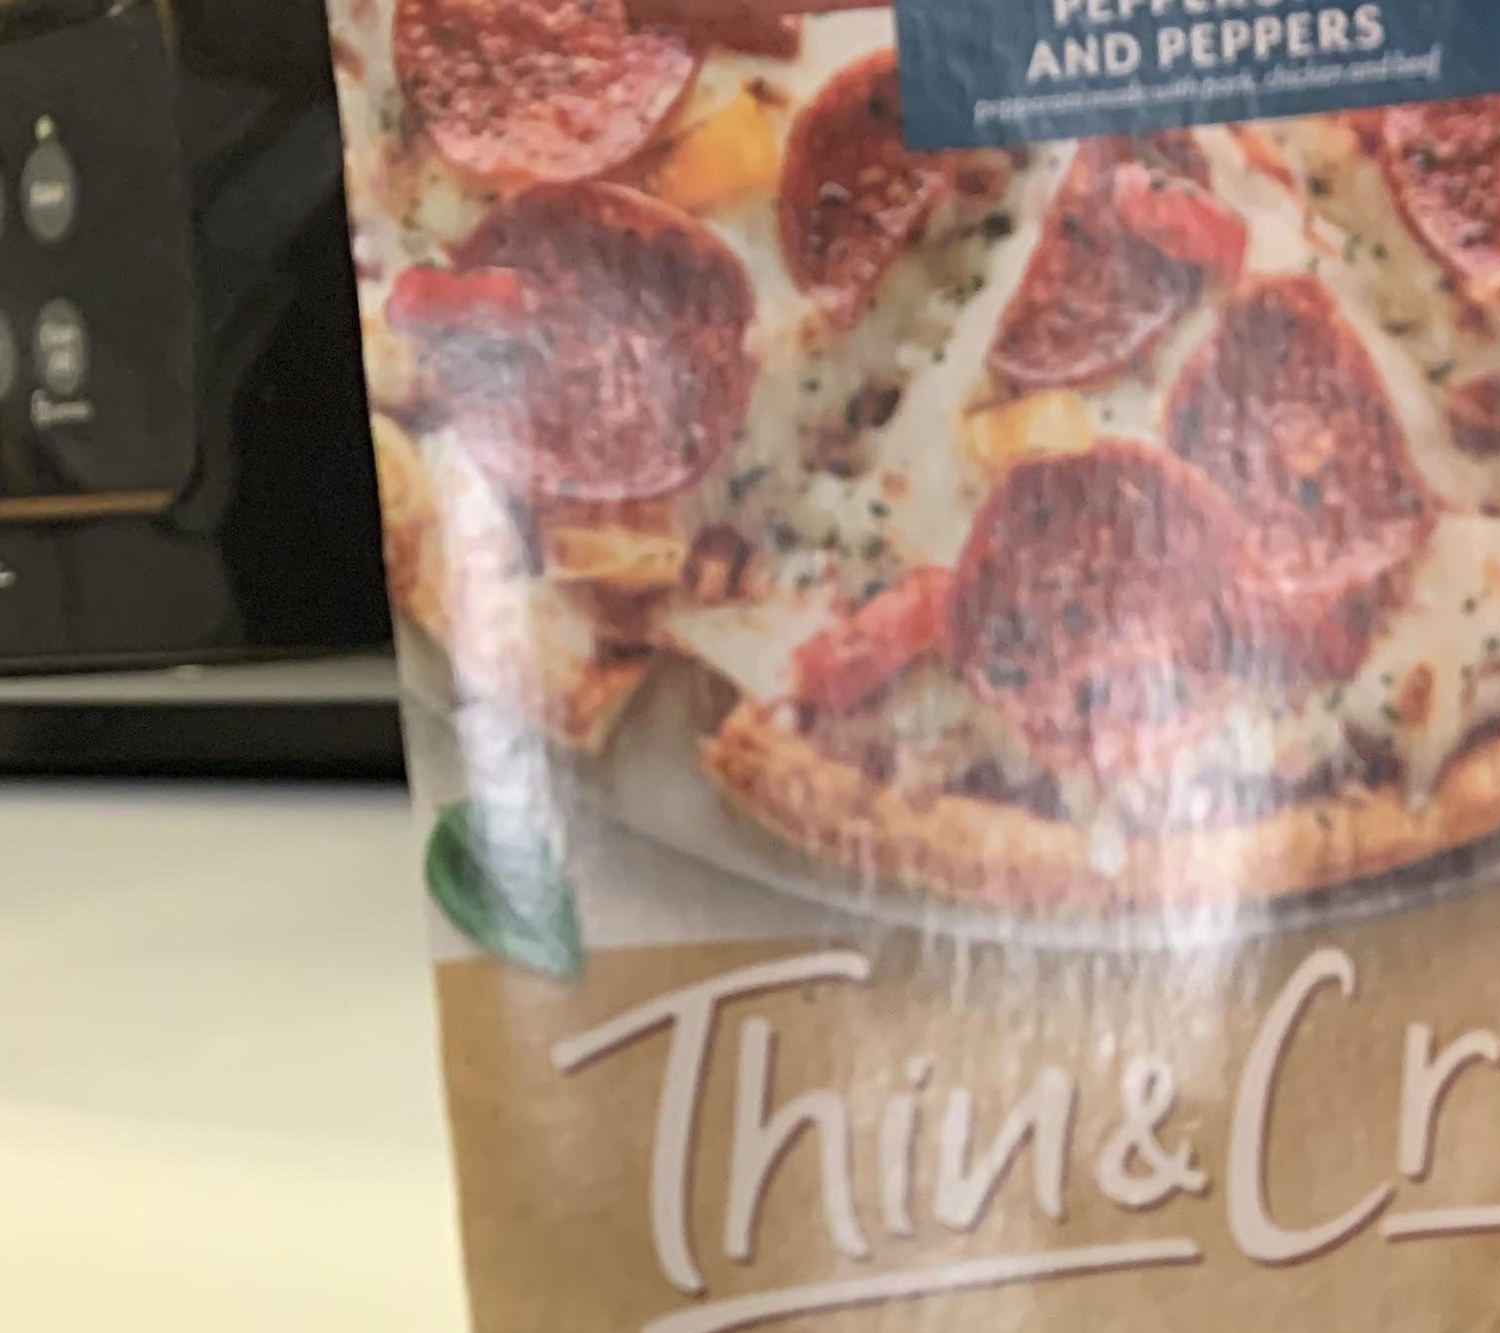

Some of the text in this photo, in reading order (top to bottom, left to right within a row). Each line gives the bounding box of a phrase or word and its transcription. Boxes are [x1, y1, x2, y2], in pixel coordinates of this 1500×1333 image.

[1028, 32, 1142, 85] AND
[1157, 4, 1387, 71] PEPPERS
[550, 950, 1077, 1297] Thin
[1097, 1054, 1212, 1213] &
